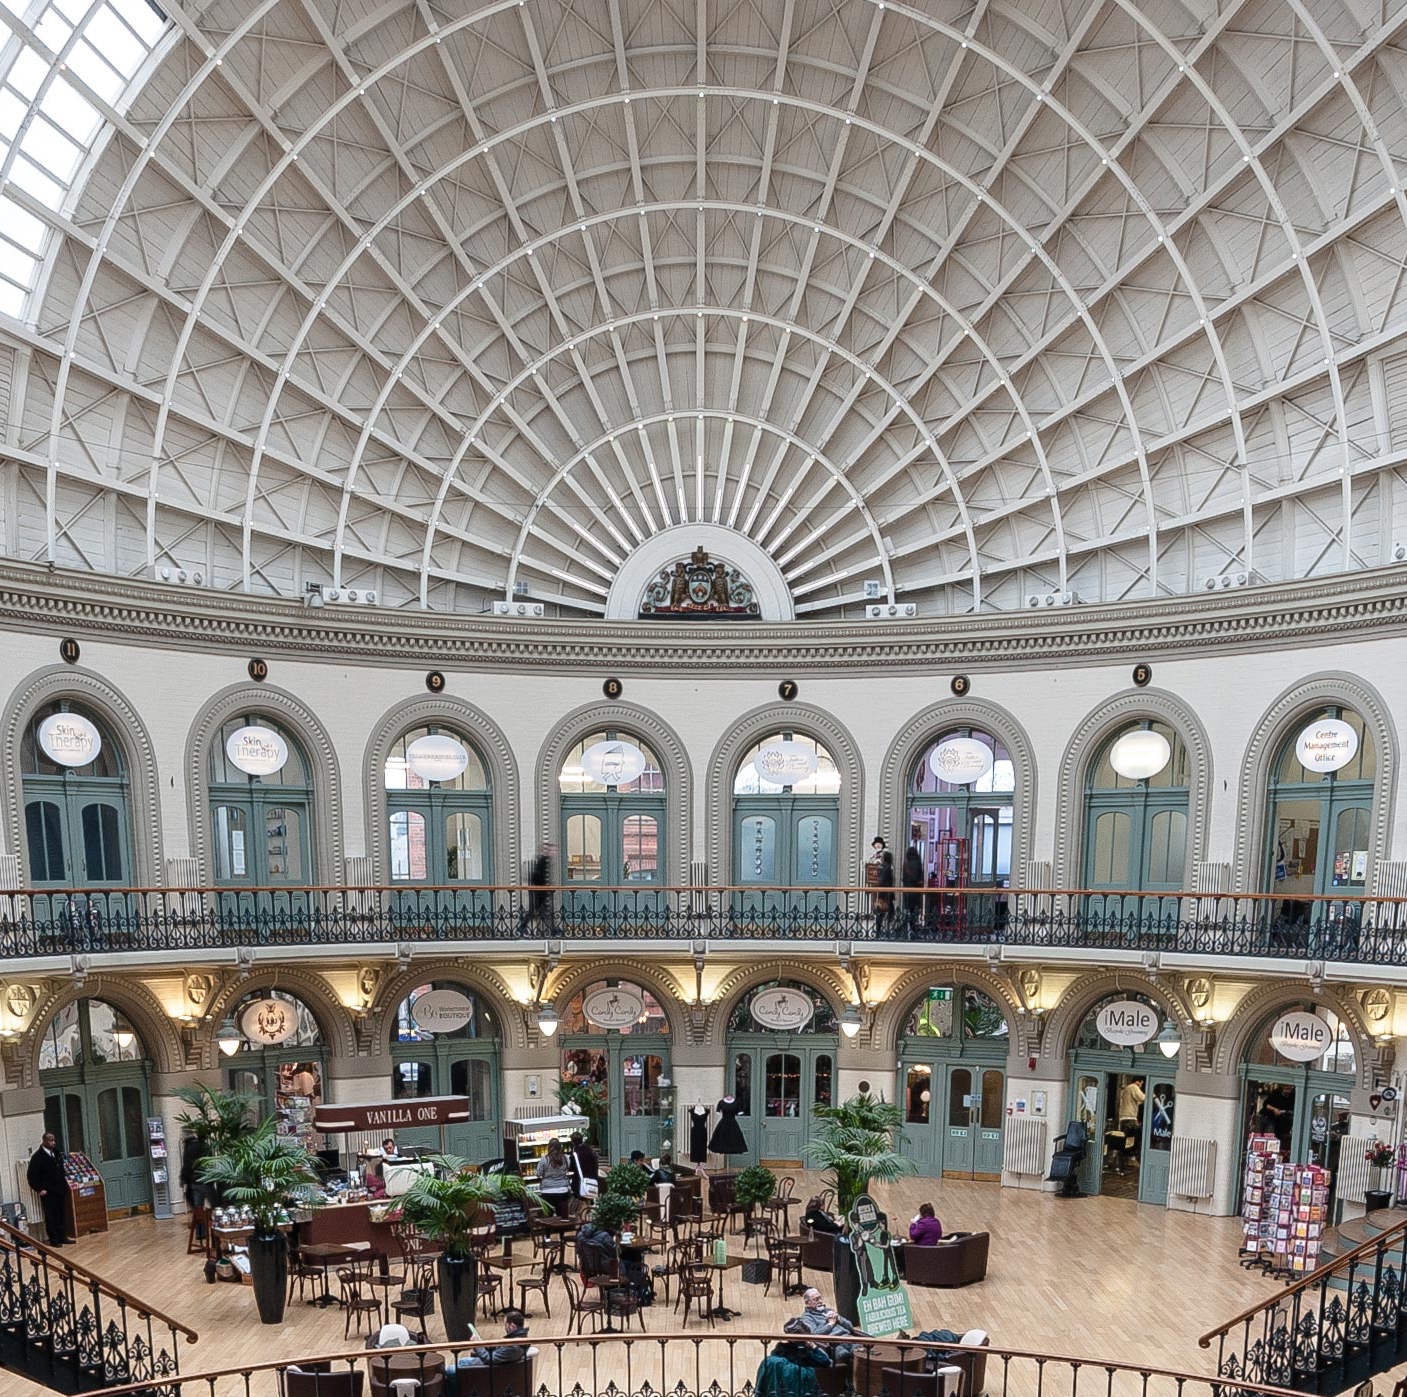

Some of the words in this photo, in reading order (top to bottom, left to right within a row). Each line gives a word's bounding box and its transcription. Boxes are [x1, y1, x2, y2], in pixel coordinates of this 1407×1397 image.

[66, 642, 76, 657] 11
[253, 662, 266, 676] 10
[1137, 668, 1146, 681] 5
[432, 675, 441, 687] 9
[608, 682, 618, 693] 8
[954, 678, 964, 690] 6
[784, 684, 793, 696] 7
[56, 724, 75, 737] Skin
[1315, 730, 1338, 739] Centre
[47, 733, 94, 752] Therapy
[243, 736, 262, 747] Skin
[1304, 740, 1350, 751] Management
[234, 744, 280, 762] Therapy
[1315, 753, 1336, 762] Office
[1104, 1009, 1150, 1028] iMale
[1280, 1021, 1324, 1042] iMale
[367, 1109, 412, 1125] VANILLA
[417, 1107, 438, 1121] ONE
[866, 1320, 893, 1336] BREWED
[891, 1315, 910, 1329] HERE
